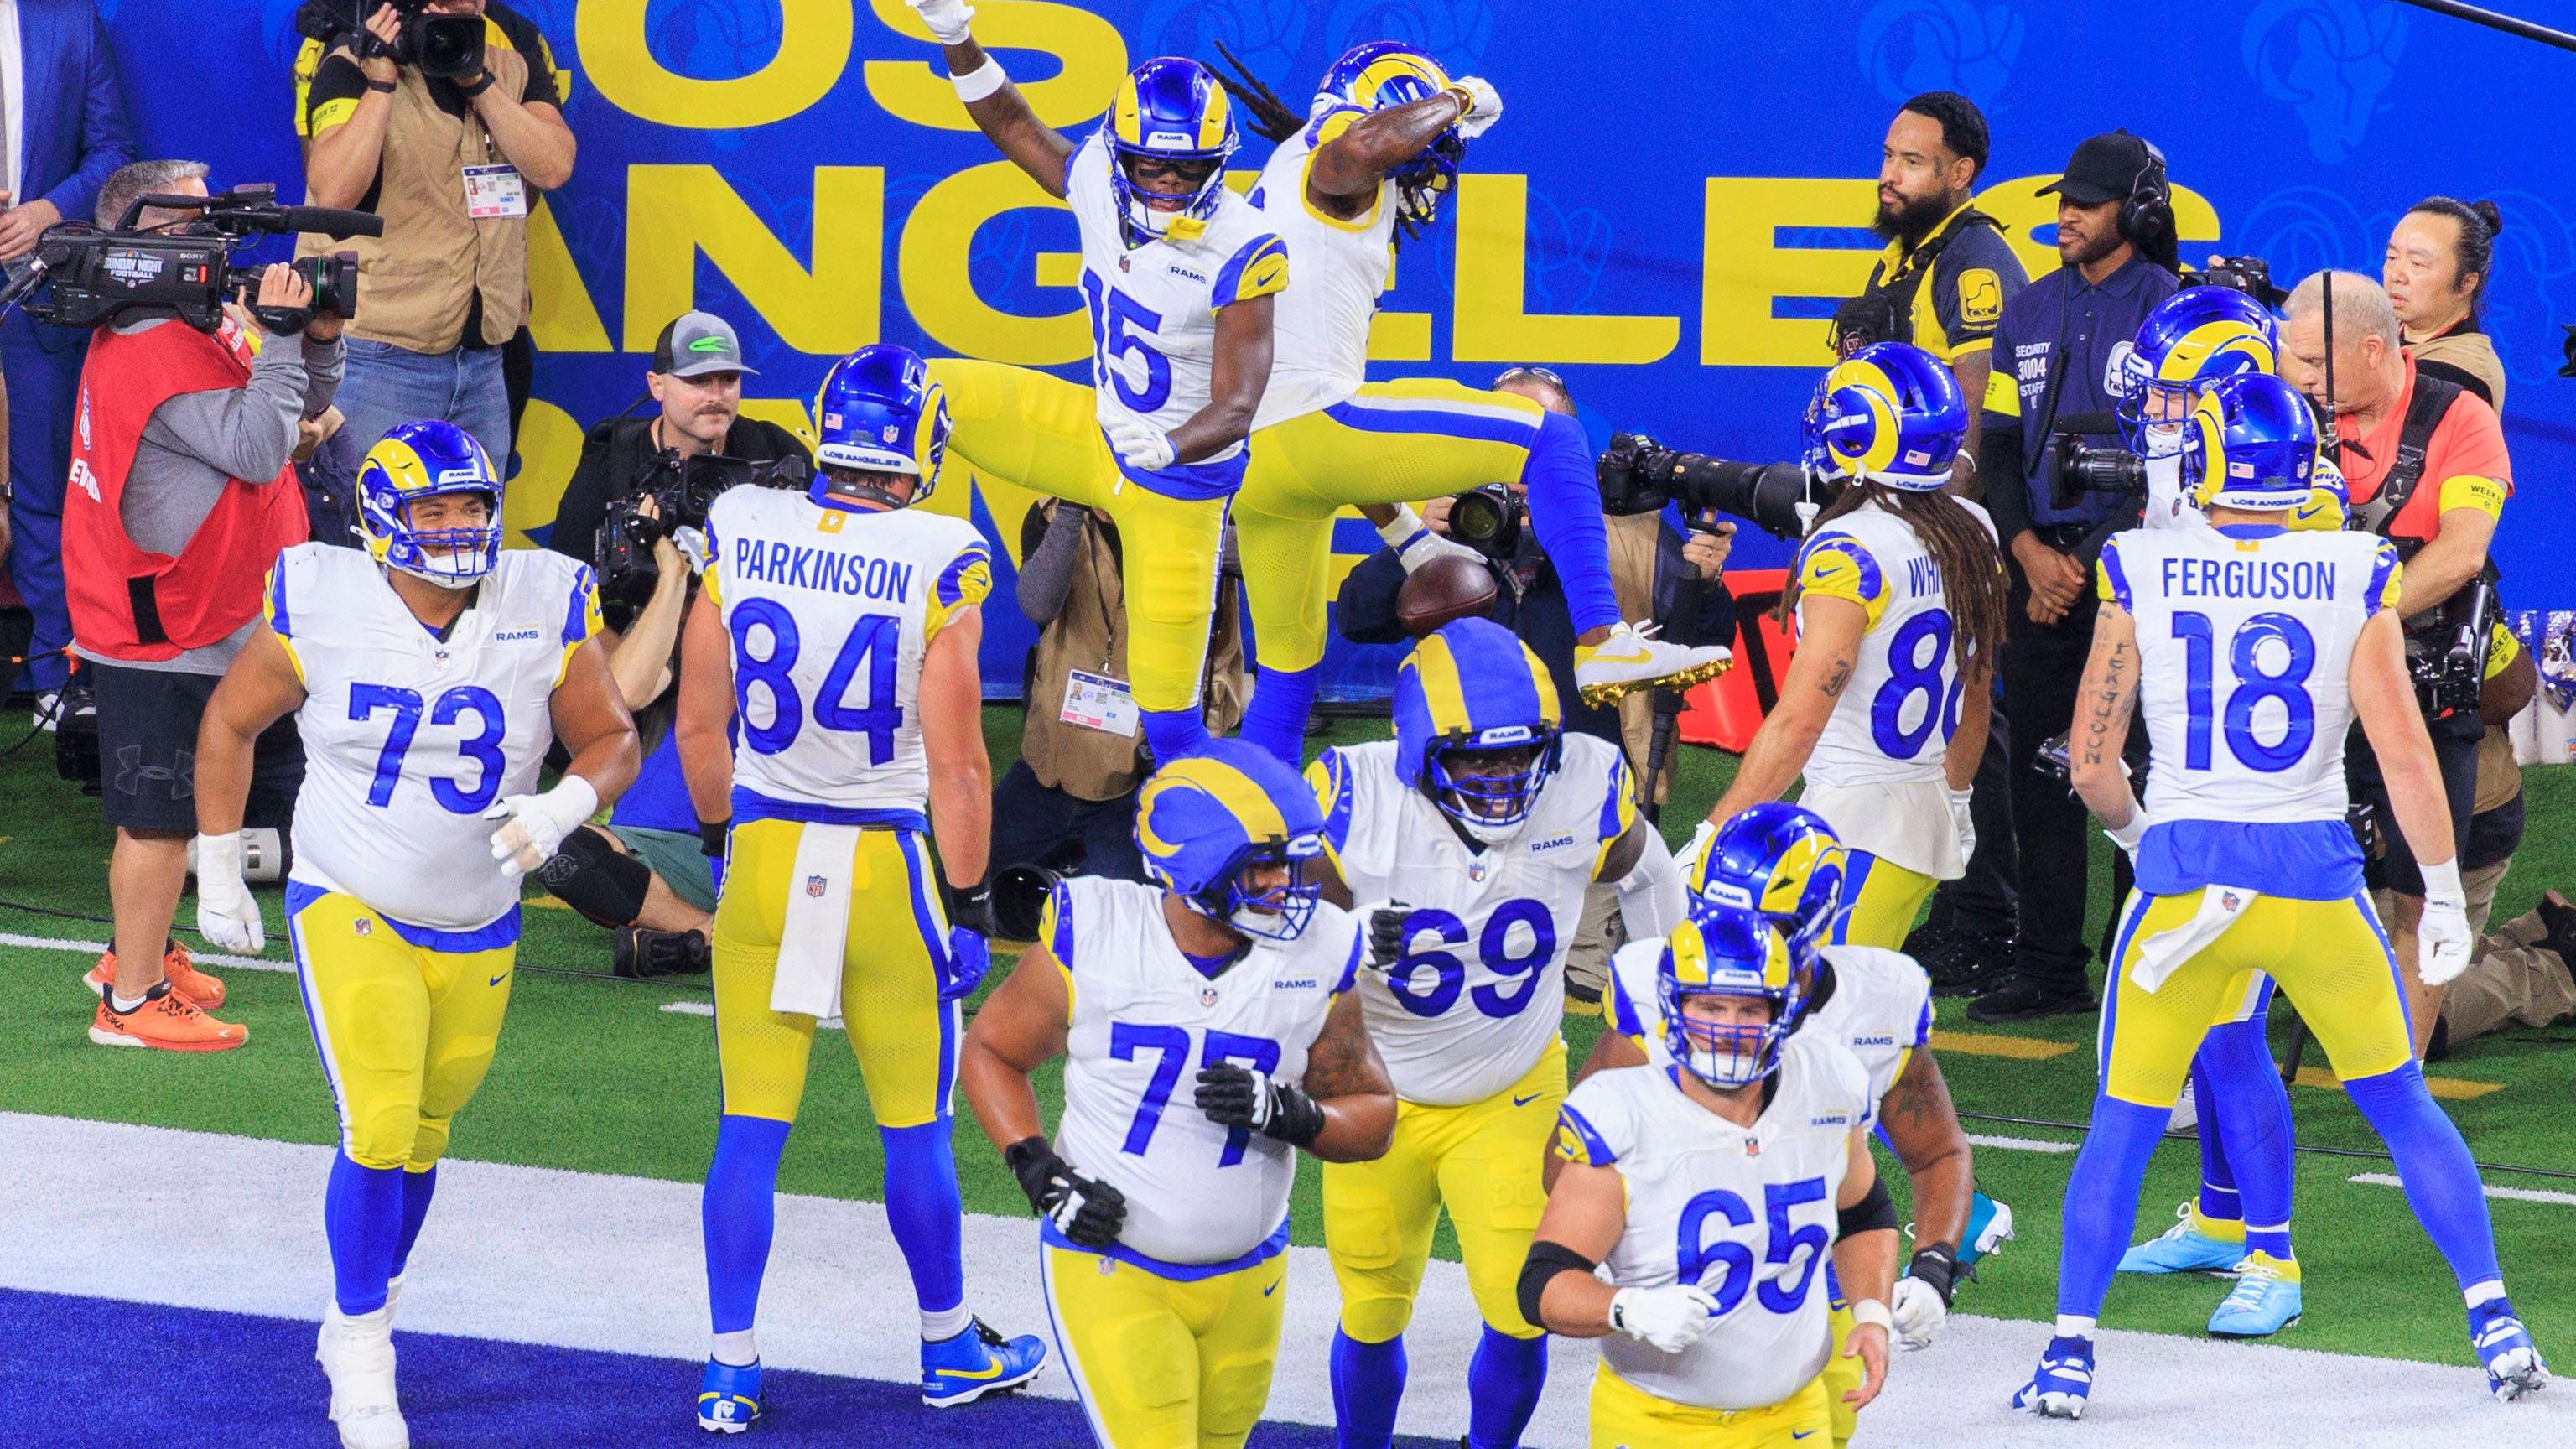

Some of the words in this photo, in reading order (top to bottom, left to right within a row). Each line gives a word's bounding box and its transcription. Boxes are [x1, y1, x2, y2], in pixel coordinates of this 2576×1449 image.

[538, 0, 1128, 131] OS
[104, 257, 136, 270] SUNDAY
[138, 259, 164, 273] NIGHT
[110, 269, 155, 279] FOOTBALL
[525, 163, 2221, 367] NGLE
[1171, 266, 1208, 284] RAMS
[1082, 267, 1172, 413] 15
[2016, 342, 2052, 357] SECURITY
[2018, 358, 2047, 382] 3004
[2019, 381, 2046, 397] STAFF
[823, 450, 844, 460] LOS
[845, 454, 901, 467] ANGELES
[2470, 485, 2496, 498] WEEK
[2231, 498, 2256, 506] LOS
[736, 538, 913, 604] PARKINSON
[2163, 558, 2336, 601] FERGUSON
[496, 630, 539, 641] RAMS
[730, 596, 903, 766] 84
[2172, 611, 2317, 773] 18
[1489, 729, 1525, 740] RAMS
[349, 683, 506, 815] 73
[1531, 835, 1574, 853] RAMS
[1389, 898, 1556, 1019] 69
[1274, 979, 1317, 989] RAMS
[101, 1006, 125, 1031] HOKA
[1853, 1036, 1893, 1046] RAMS
[1109, 1021, 1281, 1169] 77
[1810, 1116, 1847, 1126] RAMS
[1676, 1176, 1828, 1318] 65
